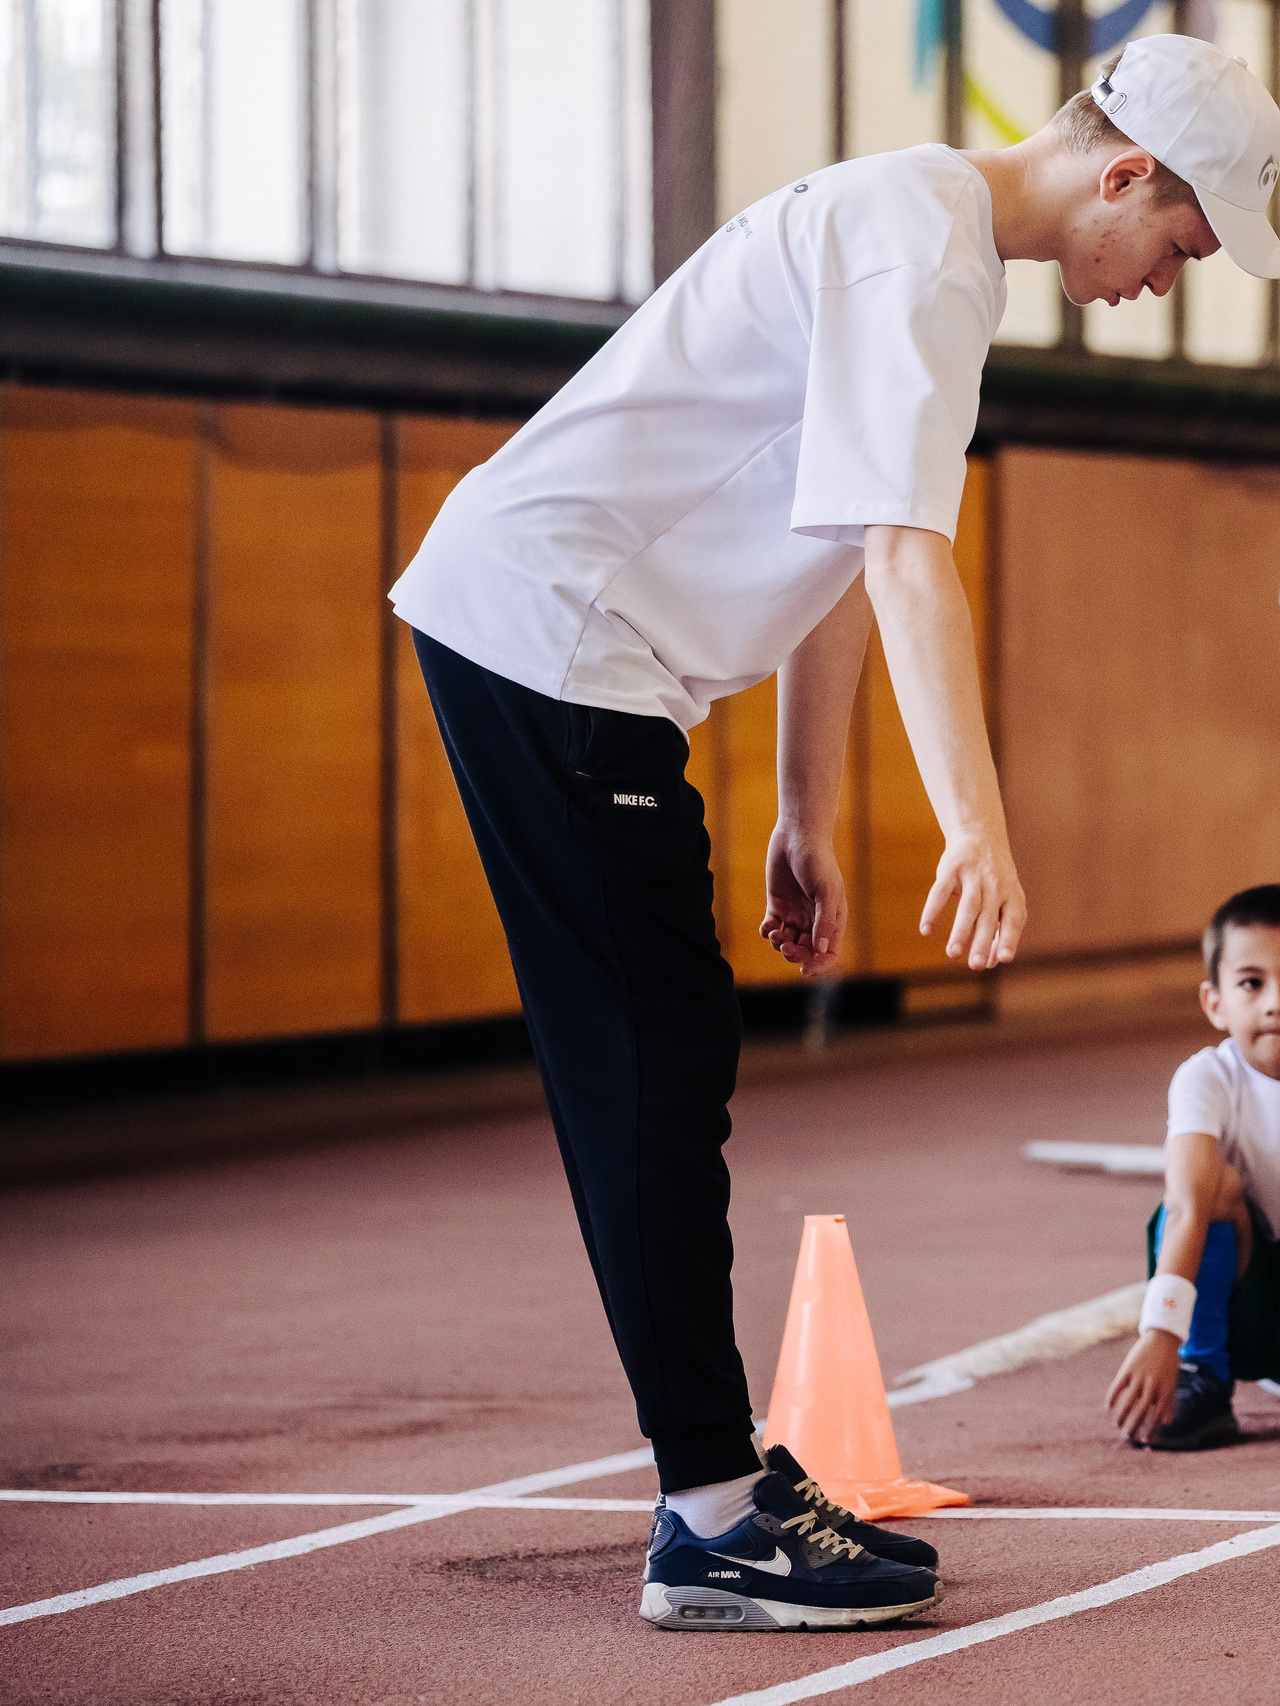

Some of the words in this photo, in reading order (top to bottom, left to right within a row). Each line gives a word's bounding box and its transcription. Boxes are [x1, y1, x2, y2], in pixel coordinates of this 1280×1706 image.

[613, 793, 638, 806] NIKE
[638, 795, 658, 807] F.C.
[720, 1570, 742, 1579] MAX
